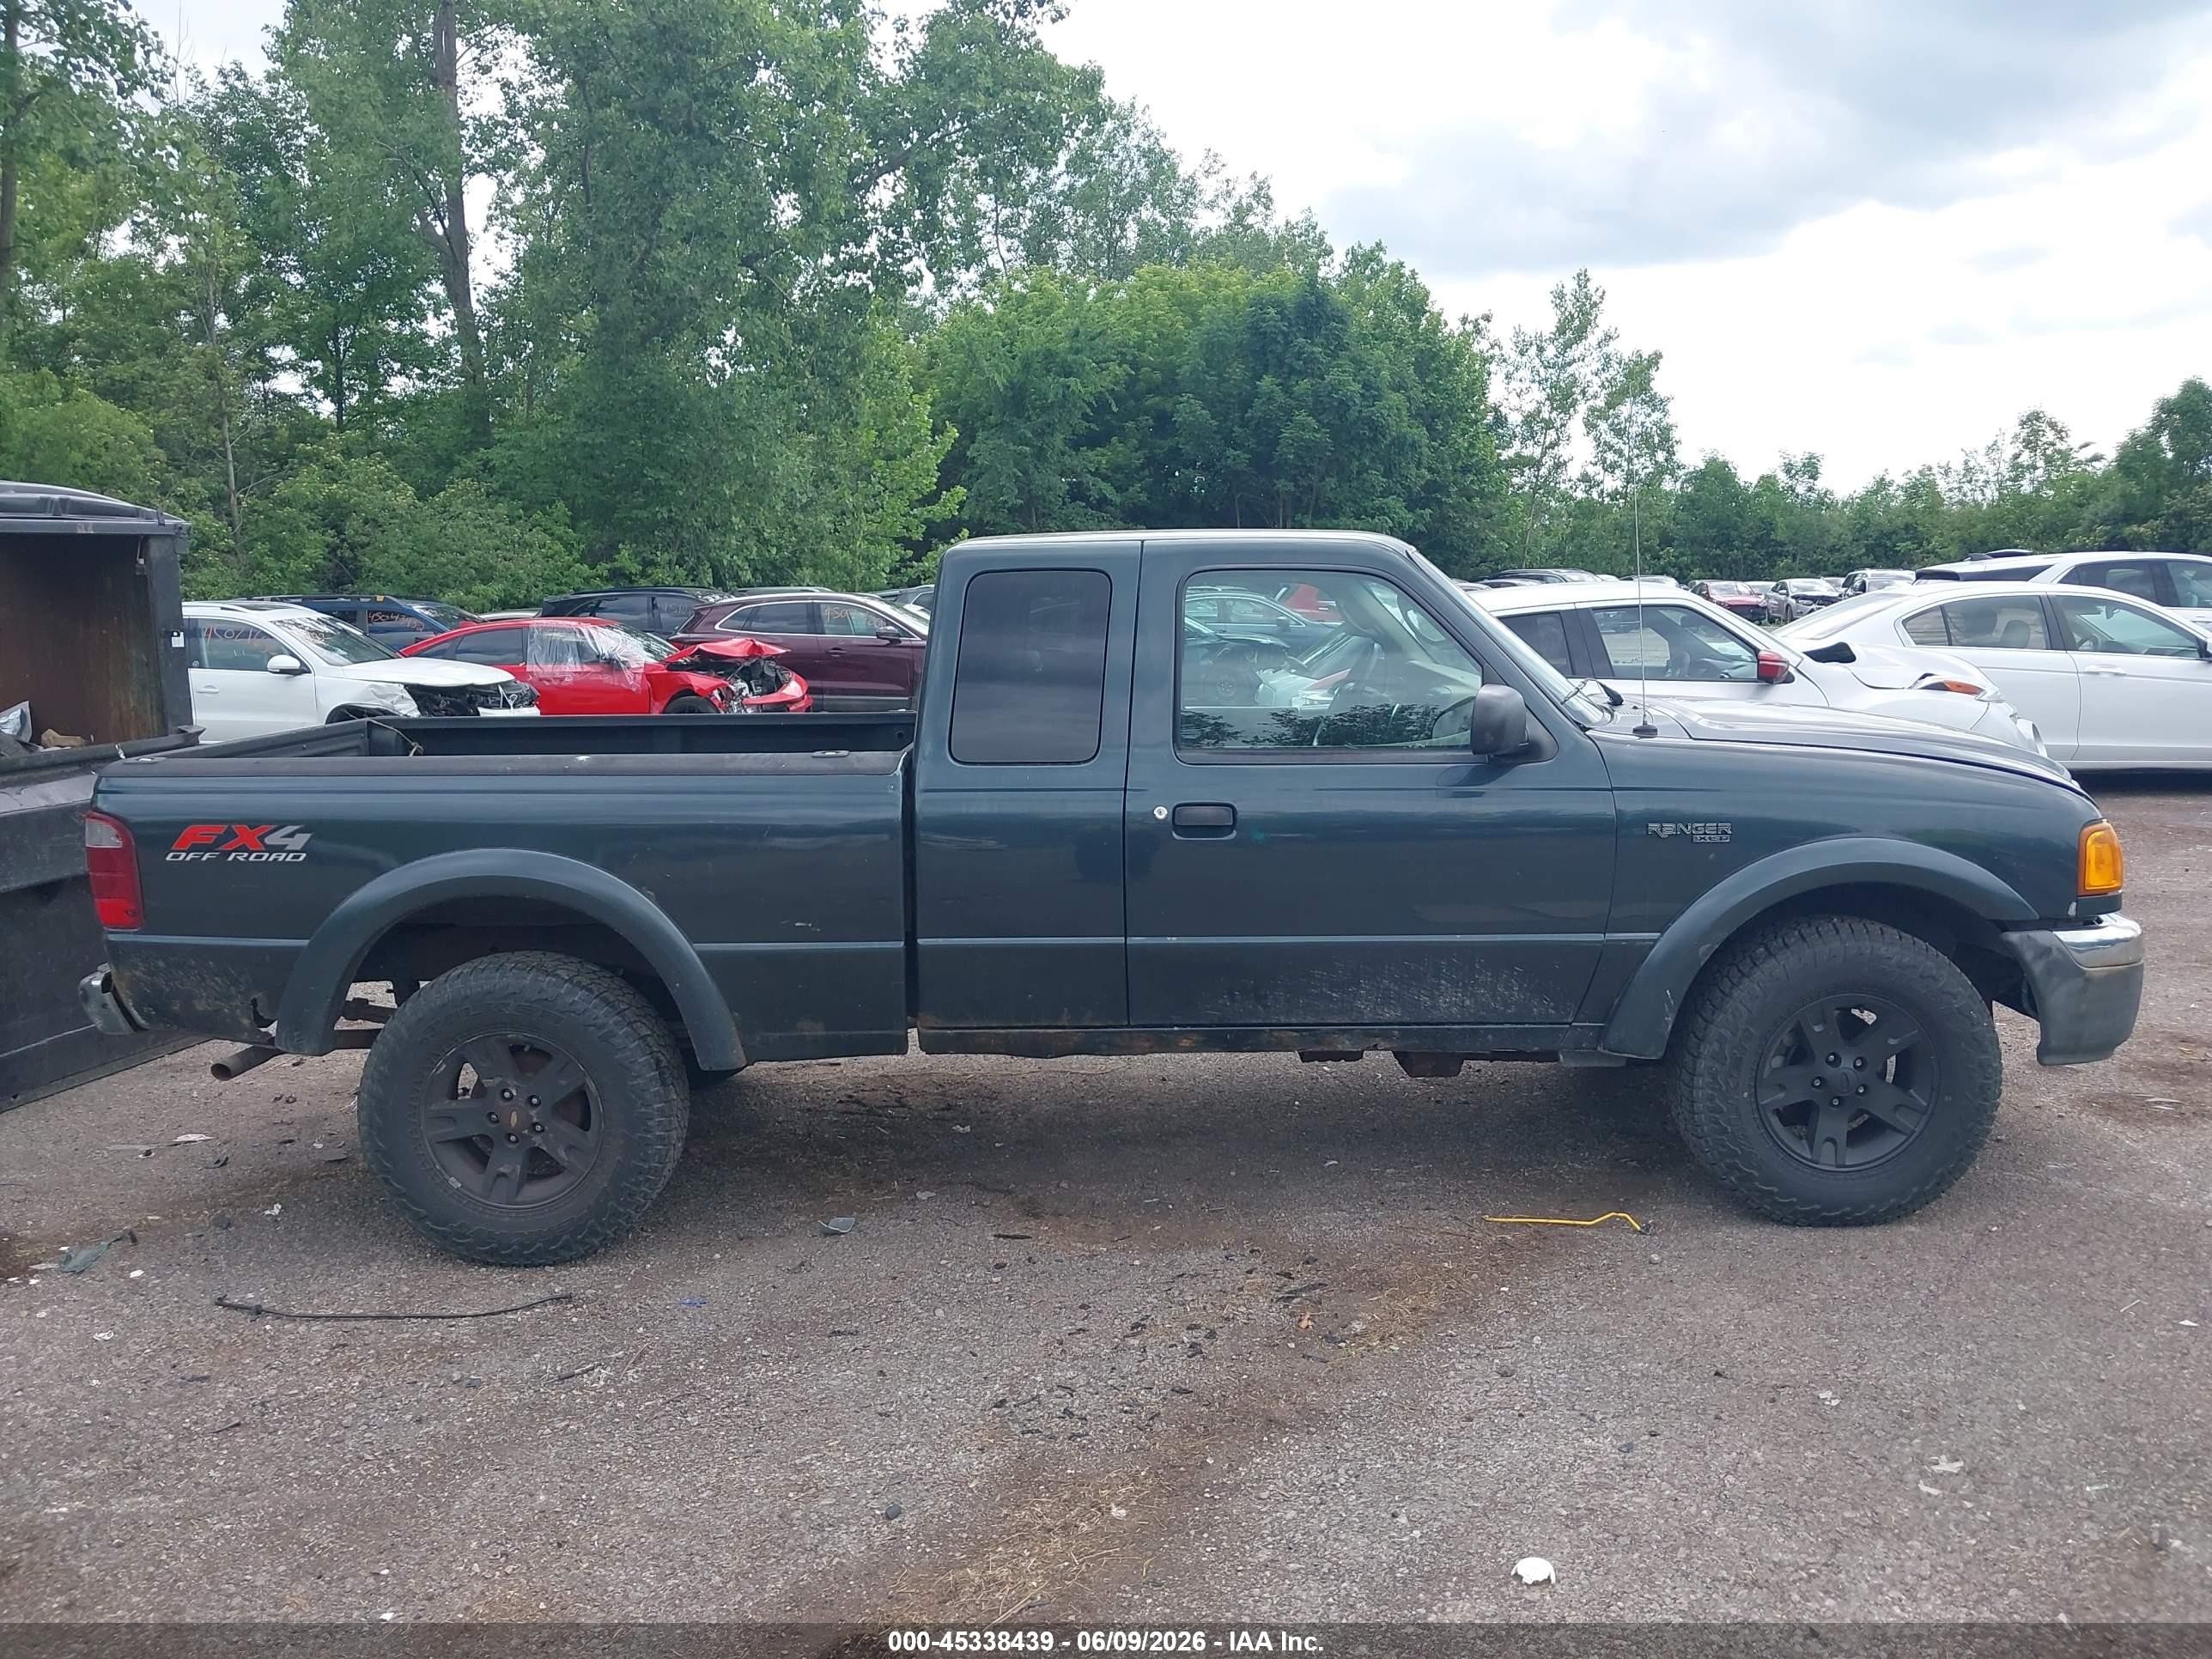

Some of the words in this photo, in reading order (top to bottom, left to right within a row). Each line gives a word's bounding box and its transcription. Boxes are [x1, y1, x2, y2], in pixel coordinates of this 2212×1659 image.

[1648, 823, 1732, 837] RANGER
[171, 824, 314, 851] FX4
[165, 852, 221, 861] OFF
[227, 852, 307, 862] ROAD
